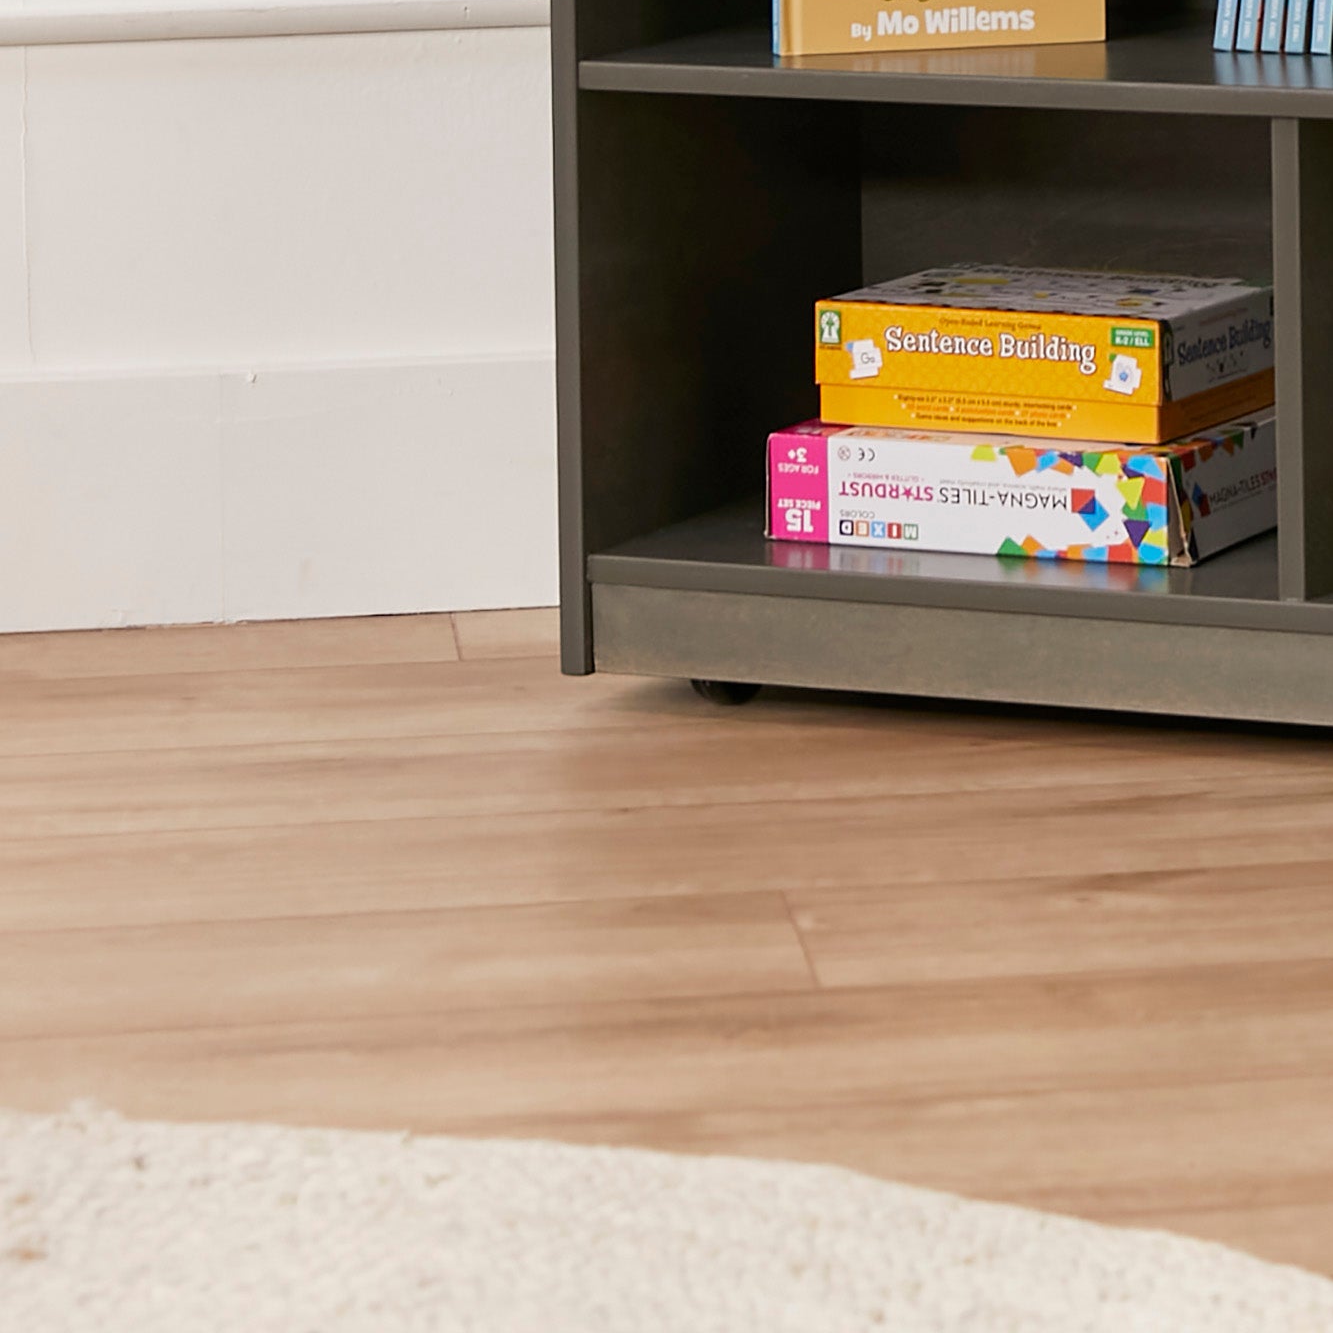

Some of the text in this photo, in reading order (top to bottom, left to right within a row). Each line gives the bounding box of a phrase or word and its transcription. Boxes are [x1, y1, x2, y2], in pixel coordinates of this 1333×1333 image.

[851, 6, 1035, 41] By Mo Willems
[884, 325, 1097, 374] Sentence Building
[1178, 319, 1273, 366] Sentence Building
[860, 353, 875, 364] Go
[787, 446, 808, 463] 3+
[778, 463, 819, 474] FOR AGES
[777, 498, 820, 510] PIECE SET
[939, 486, 1068, 511] MAGNA-TILES
[785, 507, 815, 532] 15
[840, 509, 875, 519] COLORS
[839, 519, 918, 541] MIXED
